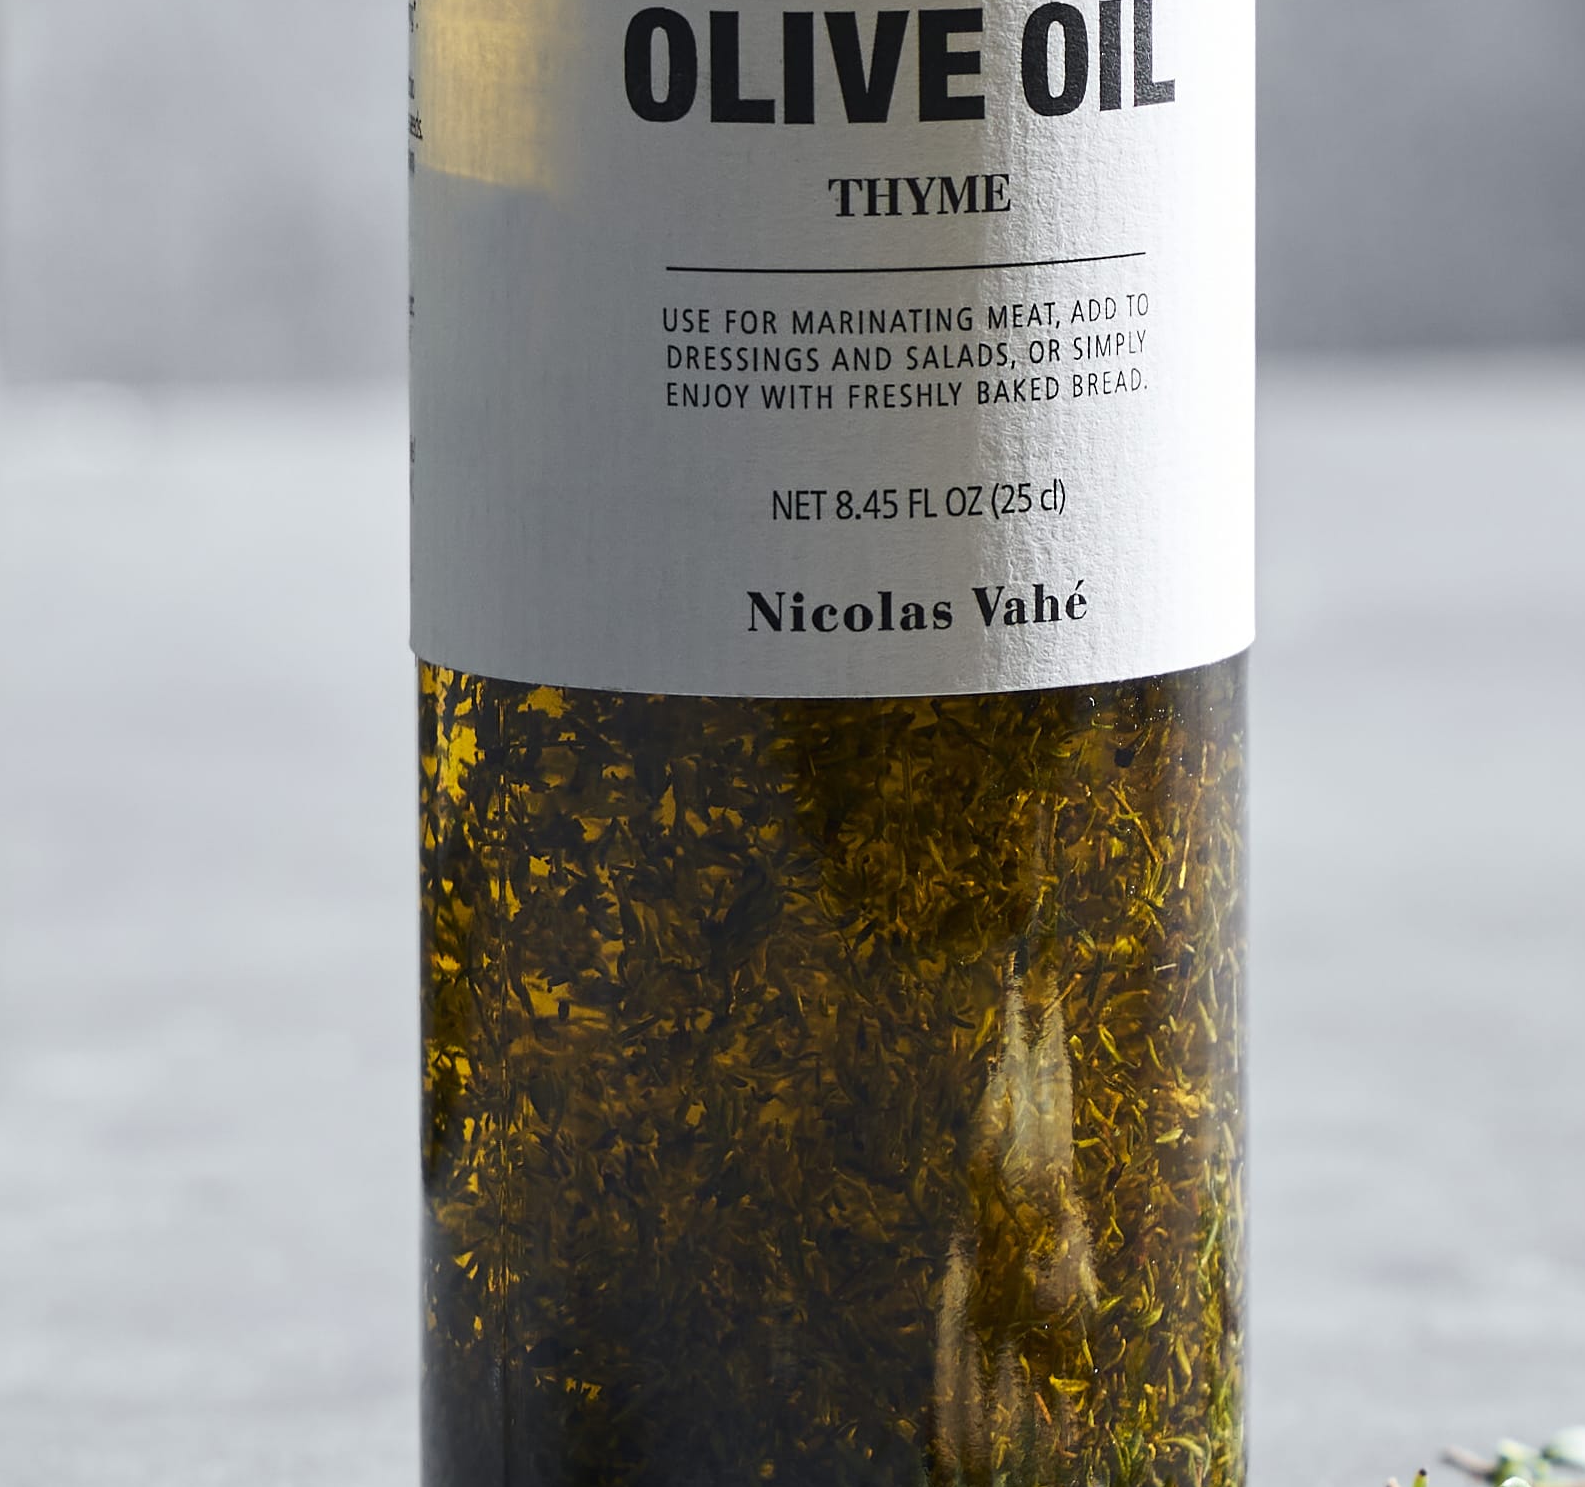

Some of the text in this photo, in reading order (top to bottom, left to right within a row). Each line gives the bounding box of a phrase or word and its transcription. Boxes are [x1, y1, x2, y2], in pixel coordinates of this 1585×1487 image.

[624, 7, 986, 125] OLIVE
[828, 174, 1011, 217] THYME
[663, 293, 1148, 335] USE FOR MARINATING MEAT, ADD TO
[667, 330, 1146, 372] DRESSINGS AND SALADS, OR SIMPLY
[667, 368, 1149, 409] ENJOY WITH FRESHLY BAKED BREAD.
[773, 478, 1065, 520] NET 8.45 FL OZ (25 cl)
[747, 580, 1088, 632] Nicolas Vahé
